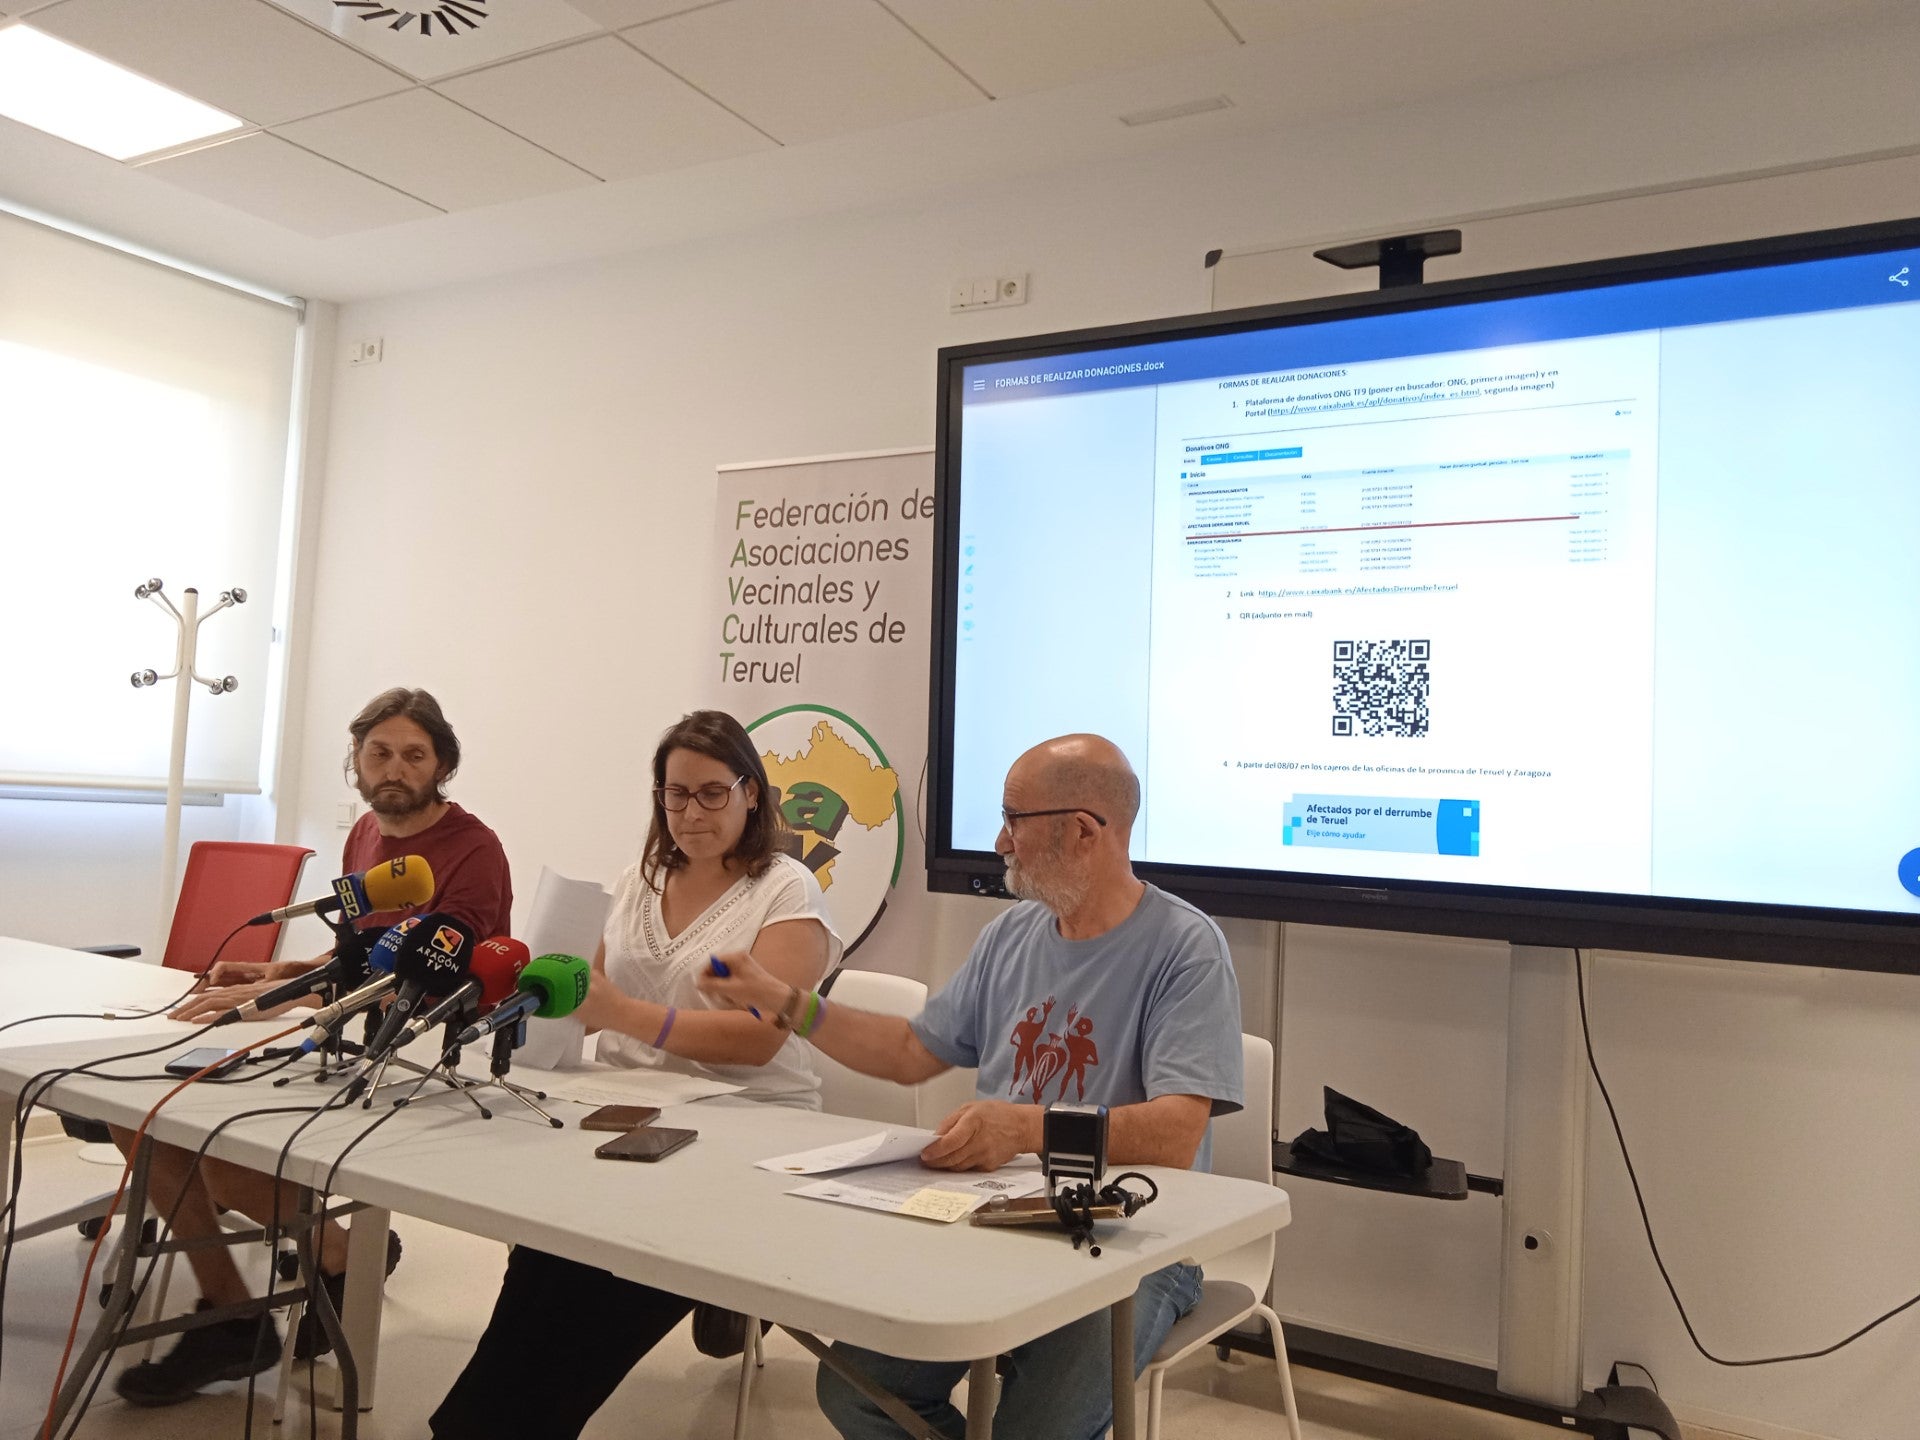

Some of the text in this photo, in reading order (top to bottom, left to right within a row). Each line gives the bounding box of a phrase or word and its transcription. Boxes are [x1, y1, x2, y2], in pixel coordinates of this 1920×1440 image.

[995, 361, 1165, 388] FORMAS DE REALIZAR DONACIONES.docx
[1218, 378, 1249, 390] FORMAS
[1250, 377, 1260, 387] DE
[1261, 374, 1296, 386] REALIZAR
[1245, 396, 1285, 408] Plataforma
[1286, 394, 1295, 403] de
[1298, 391, 1332, 403] donativos
[1333, 389, 1351, 398] ONG
[1368, 386, 1394, 396] (poner
[1395, 384, 1405, 392] en
[1470, 375, 1503, 386] primera
[1504, 371, 1539, 383] imagen)
[1540, 371, 1546, 379] y
[1245, 408, 1267, 418] Portal
[1484, 384, 1519, 396] segunda
[1520, 381, 1556, 393] imagen)
[1185, 444, 1214, 453] Donativos
[735, 487, 935, 531] Federación de
[730, 533, 910, 568] Asociaciones
[728, 573, 881, 612] Vecinales y
[722, 611, 906, 645] Culturales de
[1251, 611, 1282, 621] (adjunto
[719, 652, 802, 684] Teruel
[1236, 760, 1243, 768] A
[1243, 761, 1263, 770] partir
[1264, 761, 1276, 769] del
[1277, 762, 1299, 770] 08/07
[1311, 763, 1322, 771] los
[1323, 764, 1350, 773] cajeros
[1352, 764, 1362, 772] de
[1363, 764, 1374, 772] las
[1375, 765, 1405, 773] oficinas
[1418, 766, 1426, 774] la
[1427, 766, 1465, 775] provincia
[1466, 767, 1477, 775] de
[1479, 767, 1504, 776] Teruel
[1506, 769, 1512, 777] y
[1513, 769, 1552, 779] Zaragoza
[1306, 804, 1432, 819] Afectados por el derrumbe
[1306, 815, 1348, 826] de Teruel
[1321, 830, 1341, 838] cómo
[1342, 832, 1367, 840] ayudar
[336, 878, 361, 920] SER
[416, 945, 460, 974] ARAGÓN
[480, 939, 510, 956] rne
[426, 958, 443, 972] TV
